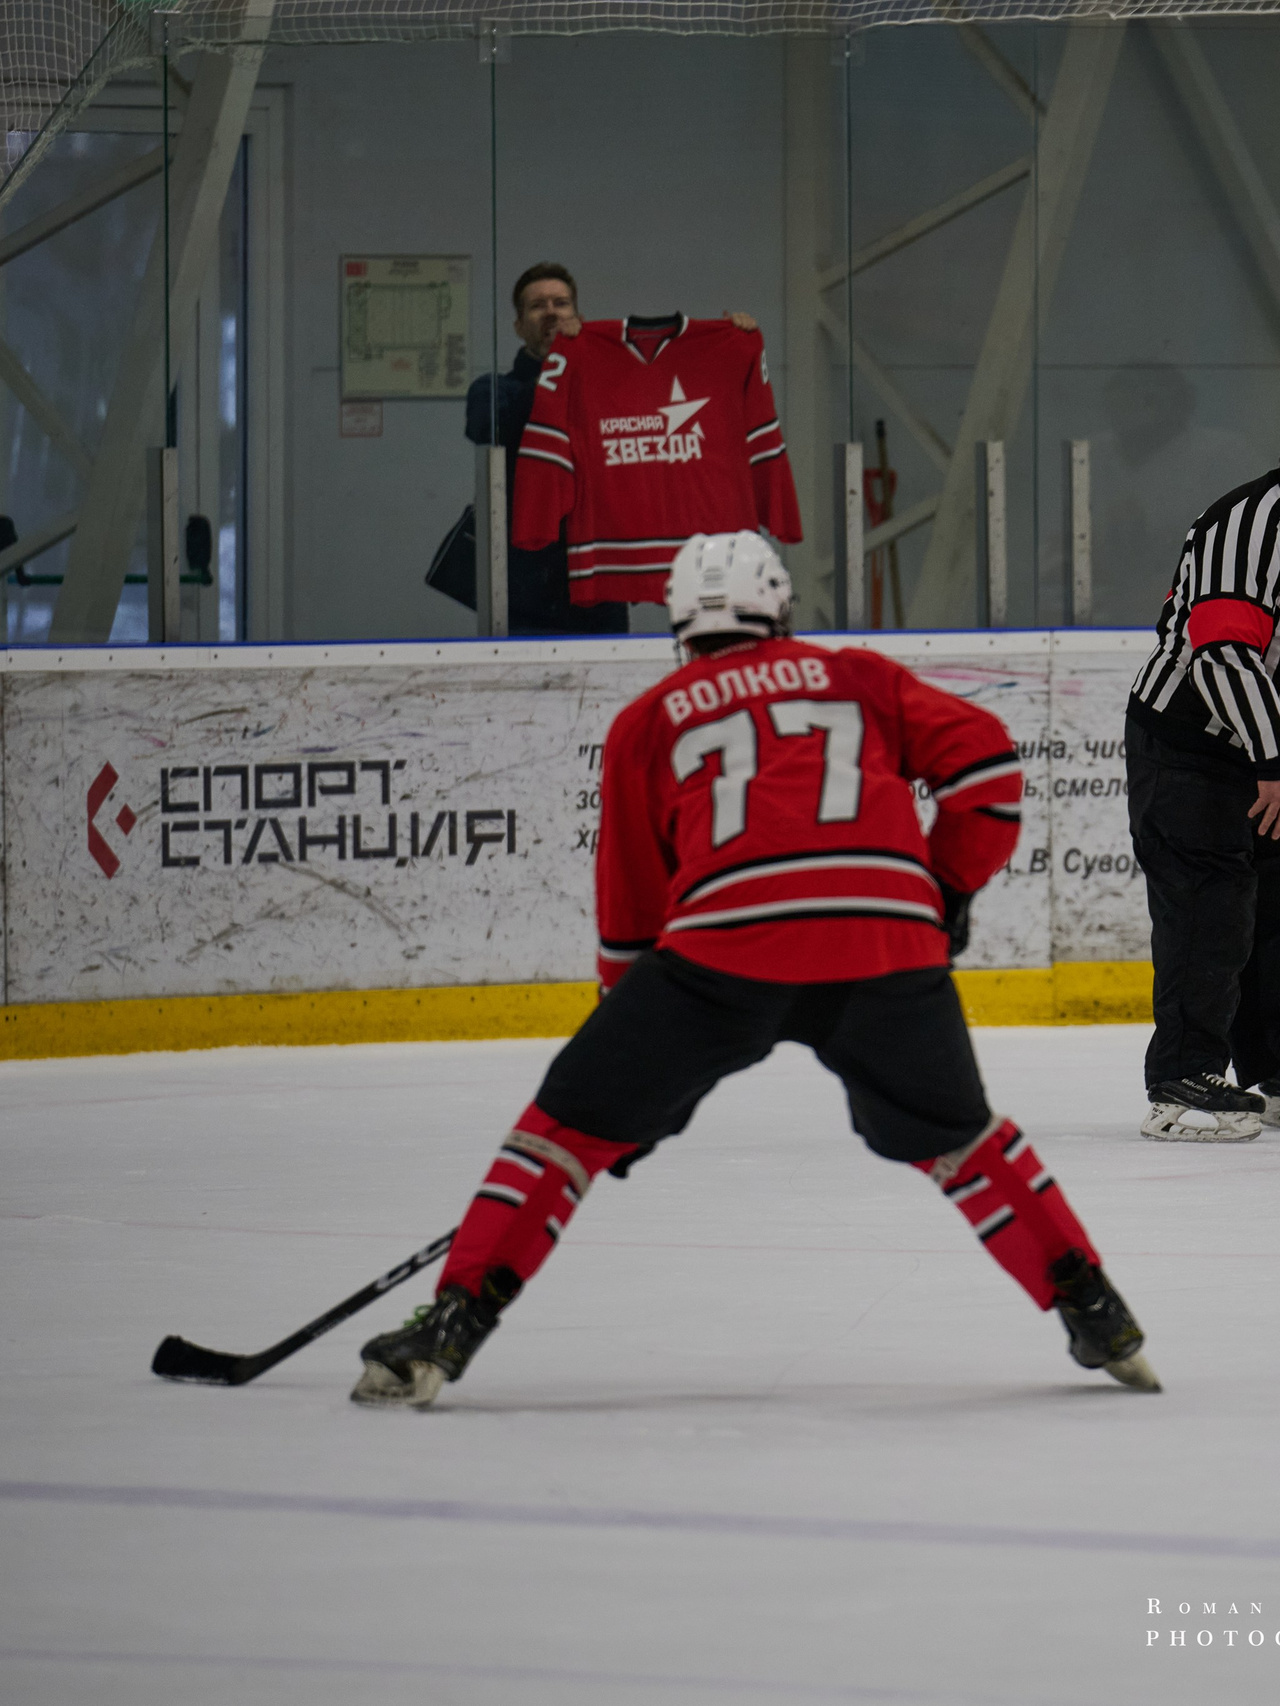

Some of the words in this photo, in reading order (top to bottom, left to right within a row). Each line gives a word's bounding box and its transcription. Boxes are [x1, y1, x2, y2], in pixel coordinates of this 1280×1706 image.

[538, 353, 567, 391] 2
[600, 415, 664, 434] КРАСНАЯ
[603, 433, 702, 466] ЗВЕЗДА
[662, 657, 831, 726] ВОЛКОВ
[160, 760, 407, 813] СПОРТ
[671, 699, 866, 848] 77
[161, 809, 516, 868] СТАНЦИЯ
